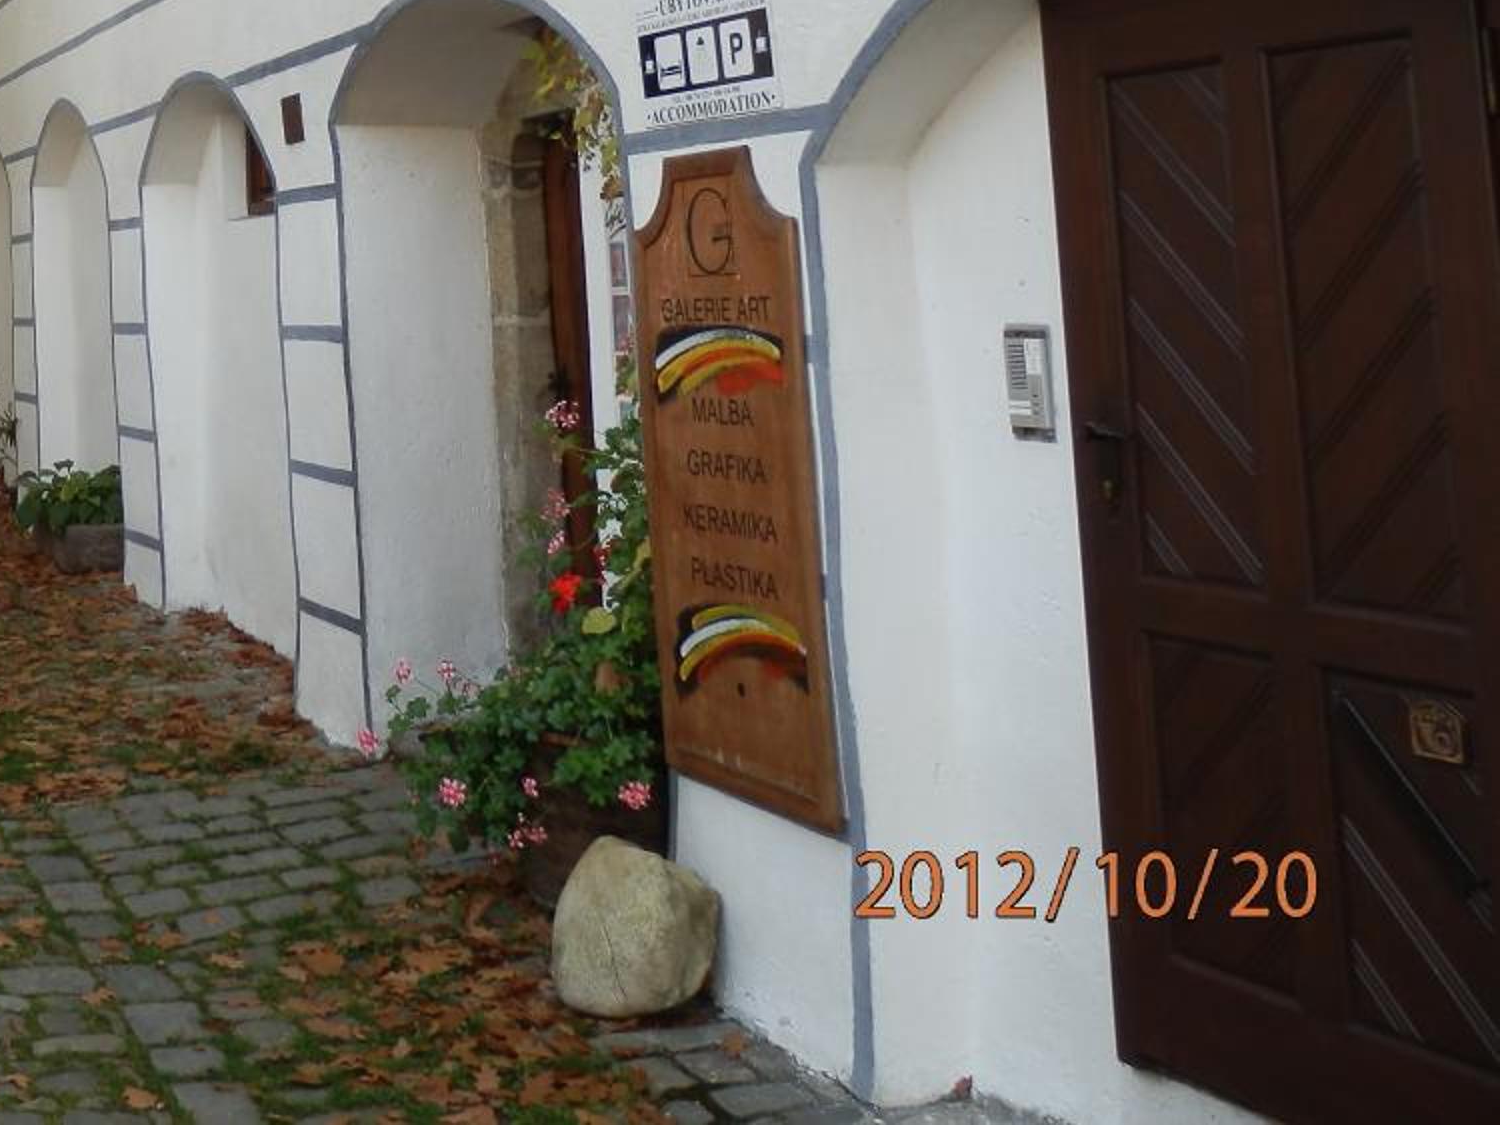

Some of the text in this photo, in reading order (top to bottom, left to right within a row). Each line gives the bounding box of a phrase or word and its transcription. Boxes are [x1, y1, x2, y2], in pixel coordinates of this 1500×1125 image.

[651, 91, 771, 123] ACCOMMODATION
[688, 187, 733, 275] G
[661, 295, 771, 322] GALERIE ART
[691, 396, 755, 427] MALBA
[686, 448, 768, 485] GRAFIKA
[682, 501, 779, 543] KERAMIKA
[690, 555, 780, 601] PLASTIKA
